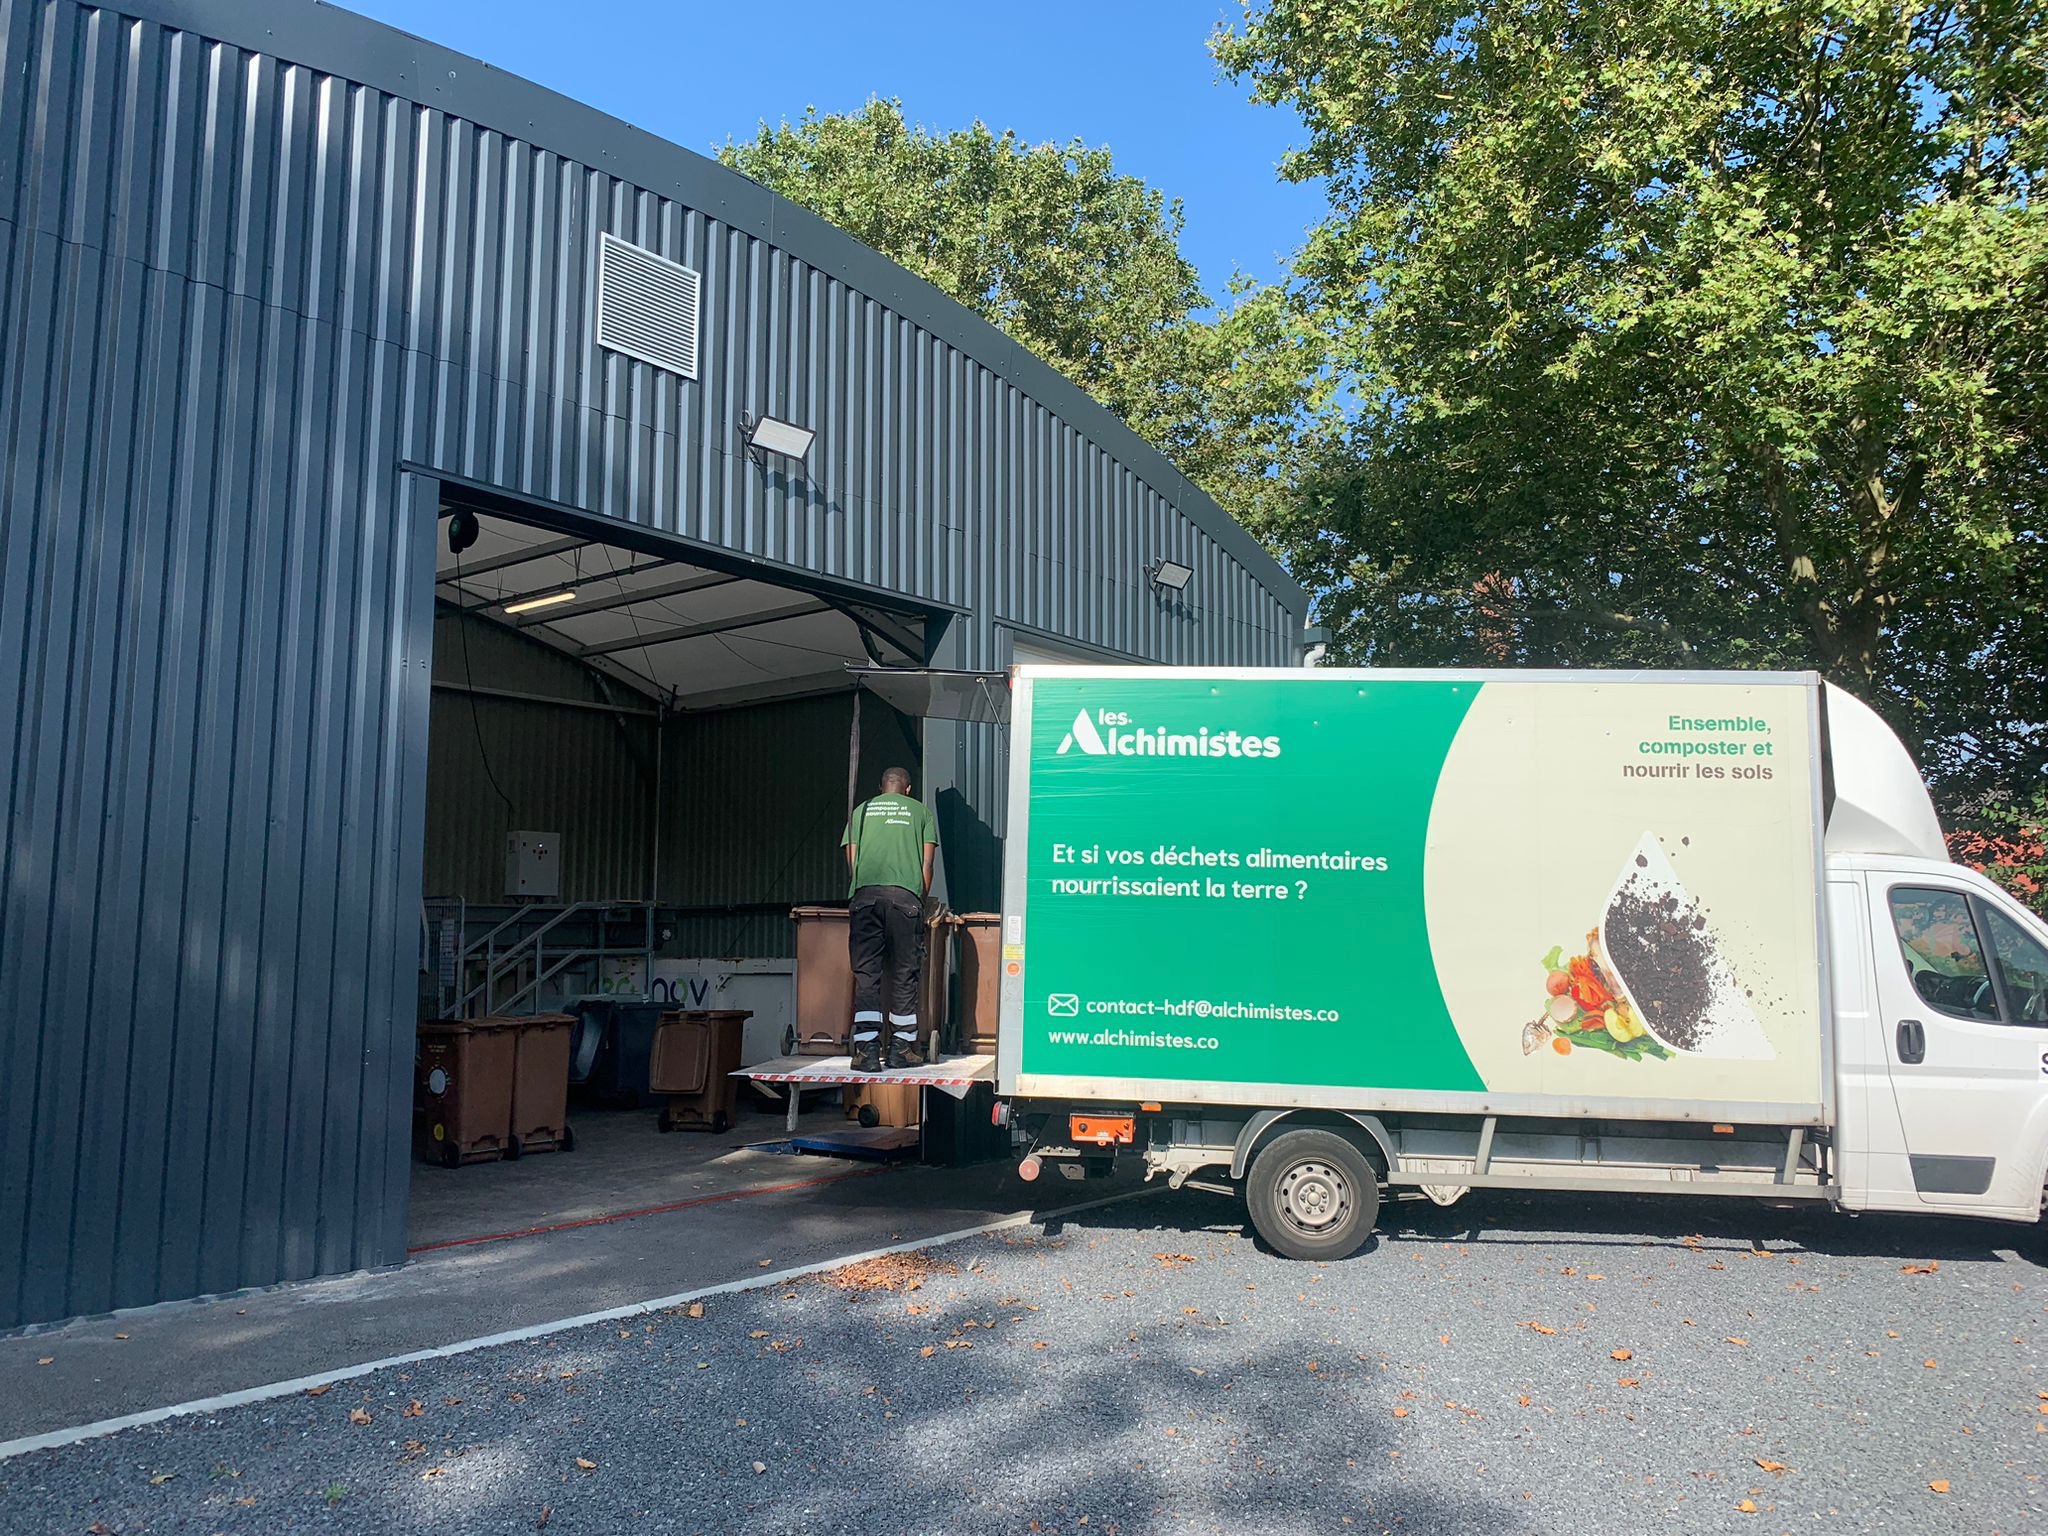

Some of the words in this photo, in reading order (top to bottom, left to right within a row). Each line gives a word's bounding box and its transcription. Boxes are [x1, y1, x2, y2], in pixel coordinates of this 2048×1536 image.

[1099, 708, 1128, 726] les
[1669, 715, 1772, 735] Ensemble,
[1056, 707, 1281, 758] Alchimistes
[1639, 740, 1747, 757] composter
[1752, 741, 1773, 756] et
[1623, 763, 1690, 778] nourrir
[1695, 763, 1725, 779] les
[1731, 764, 1773, 780] sols
[1052, 843, 1075, 864] Et
[1081, 844, 1099, 864] si
[1105, 849, 1145, 866] vos
[1150, 845, 1240, 868] déchets
[1246, 848, 1389, 872] alimentaires
[1052, 875, 1200, 897] nourrissaient
[1206, 877, 1226, 898] la
[1232, 881, 1289, 900] terre
[1294, 880, 1308, 900] ?
[1086, 998, 1339, 1022] contact-hdf@alchimistes.co
[1048, 1029, 1219, 1050] www.alchimistes.co
